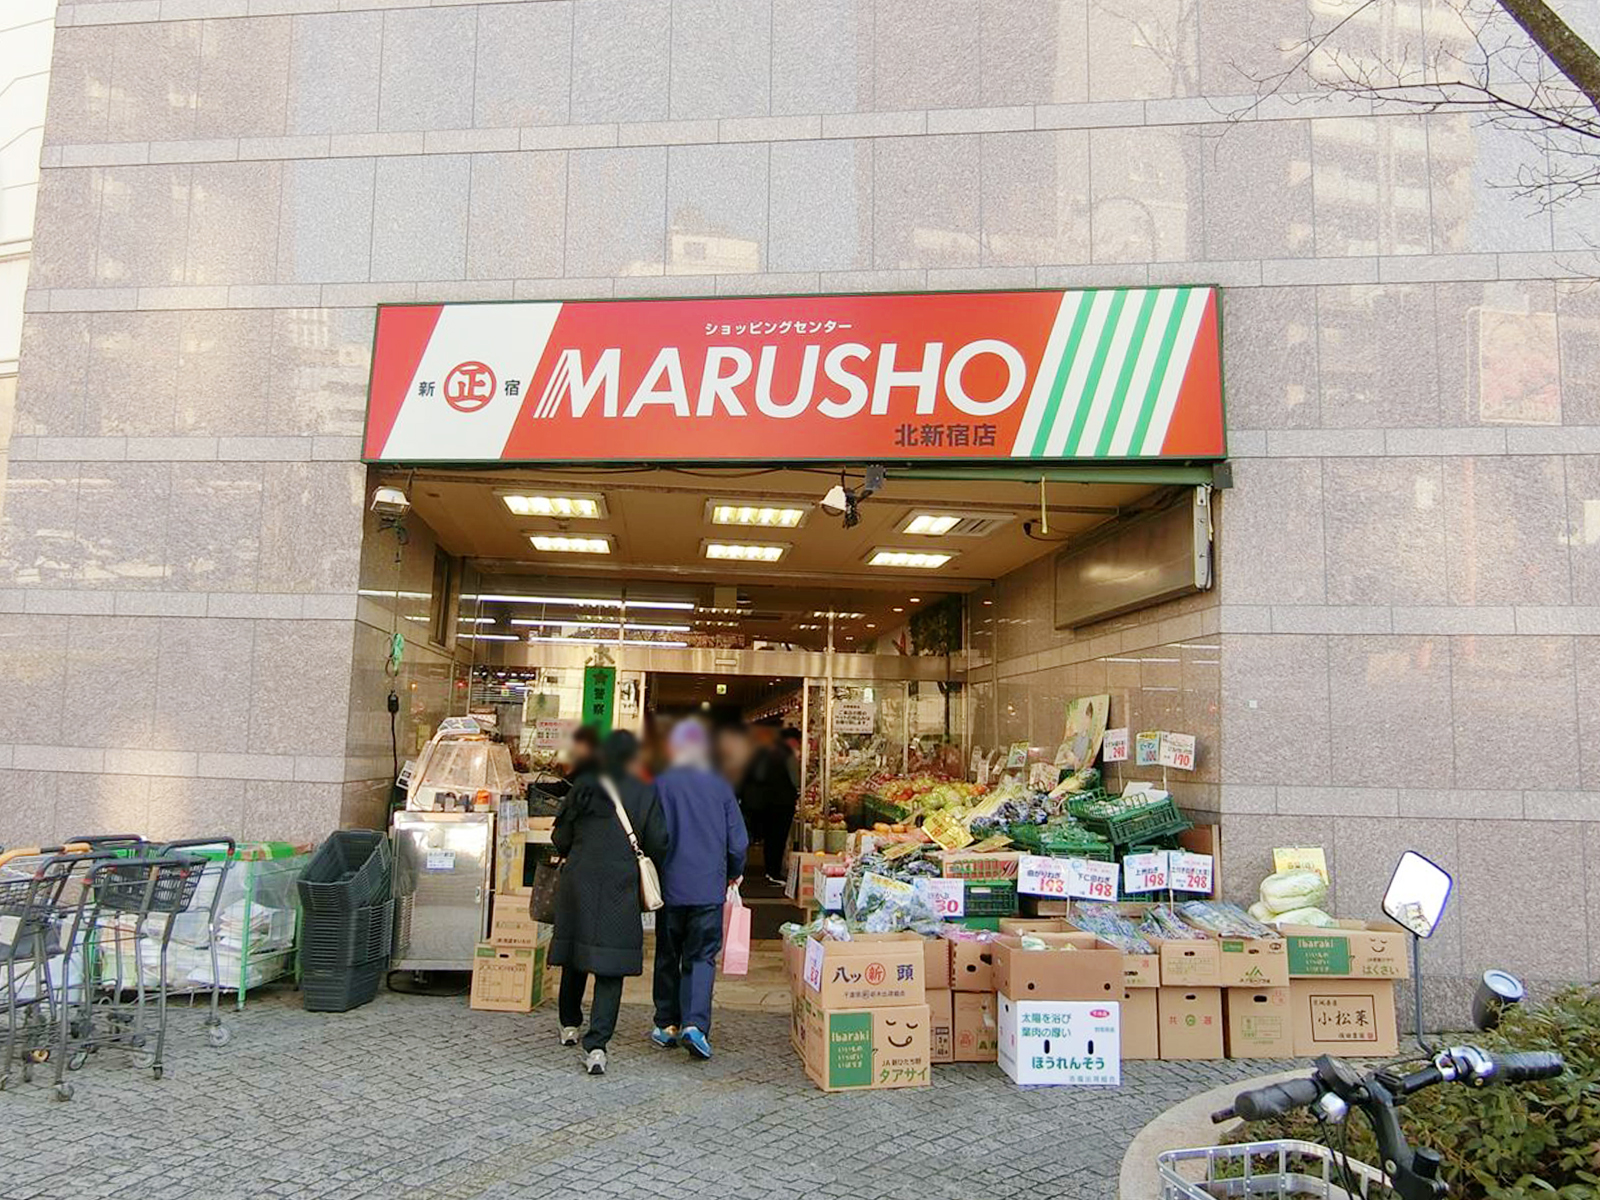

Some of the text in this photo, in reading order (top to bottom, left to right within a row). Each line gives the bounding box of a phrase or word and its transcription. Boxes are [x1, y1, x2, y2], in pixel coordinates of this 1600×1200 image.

[706, 321, 851, 335] ショッピングセンター
[533, 339, 1026, 419] MARUSHO
[418, 381, 435, 397] 新
[504, 379, 521, 396] 宿
[895, 423, 996, 448] 北新宿店
[1040, 878, 1065, 894] 198
[1144, 872, 1165, 888] 198
[1187, 875, 1208, 889] 298
[1088, 882, 1113, 897] 198
[867, 964, 884, 983] 新
[897, 964, 914, 981] 頭
[1363, 965, 1399, 976] はくさい
[1021, 1012, 1071, 1024] 太陽を浴び
[1317, 1009, 1369, 1026] 小松菜
[831, 1031, 870, 1042] Ibaraki
[1021, 1027, 1071, 1038] 葉肉の厚い
[1032, 1056, 1105, 1070] ほうれんそう
[880, 1067, 928, 1083] タアサイ
